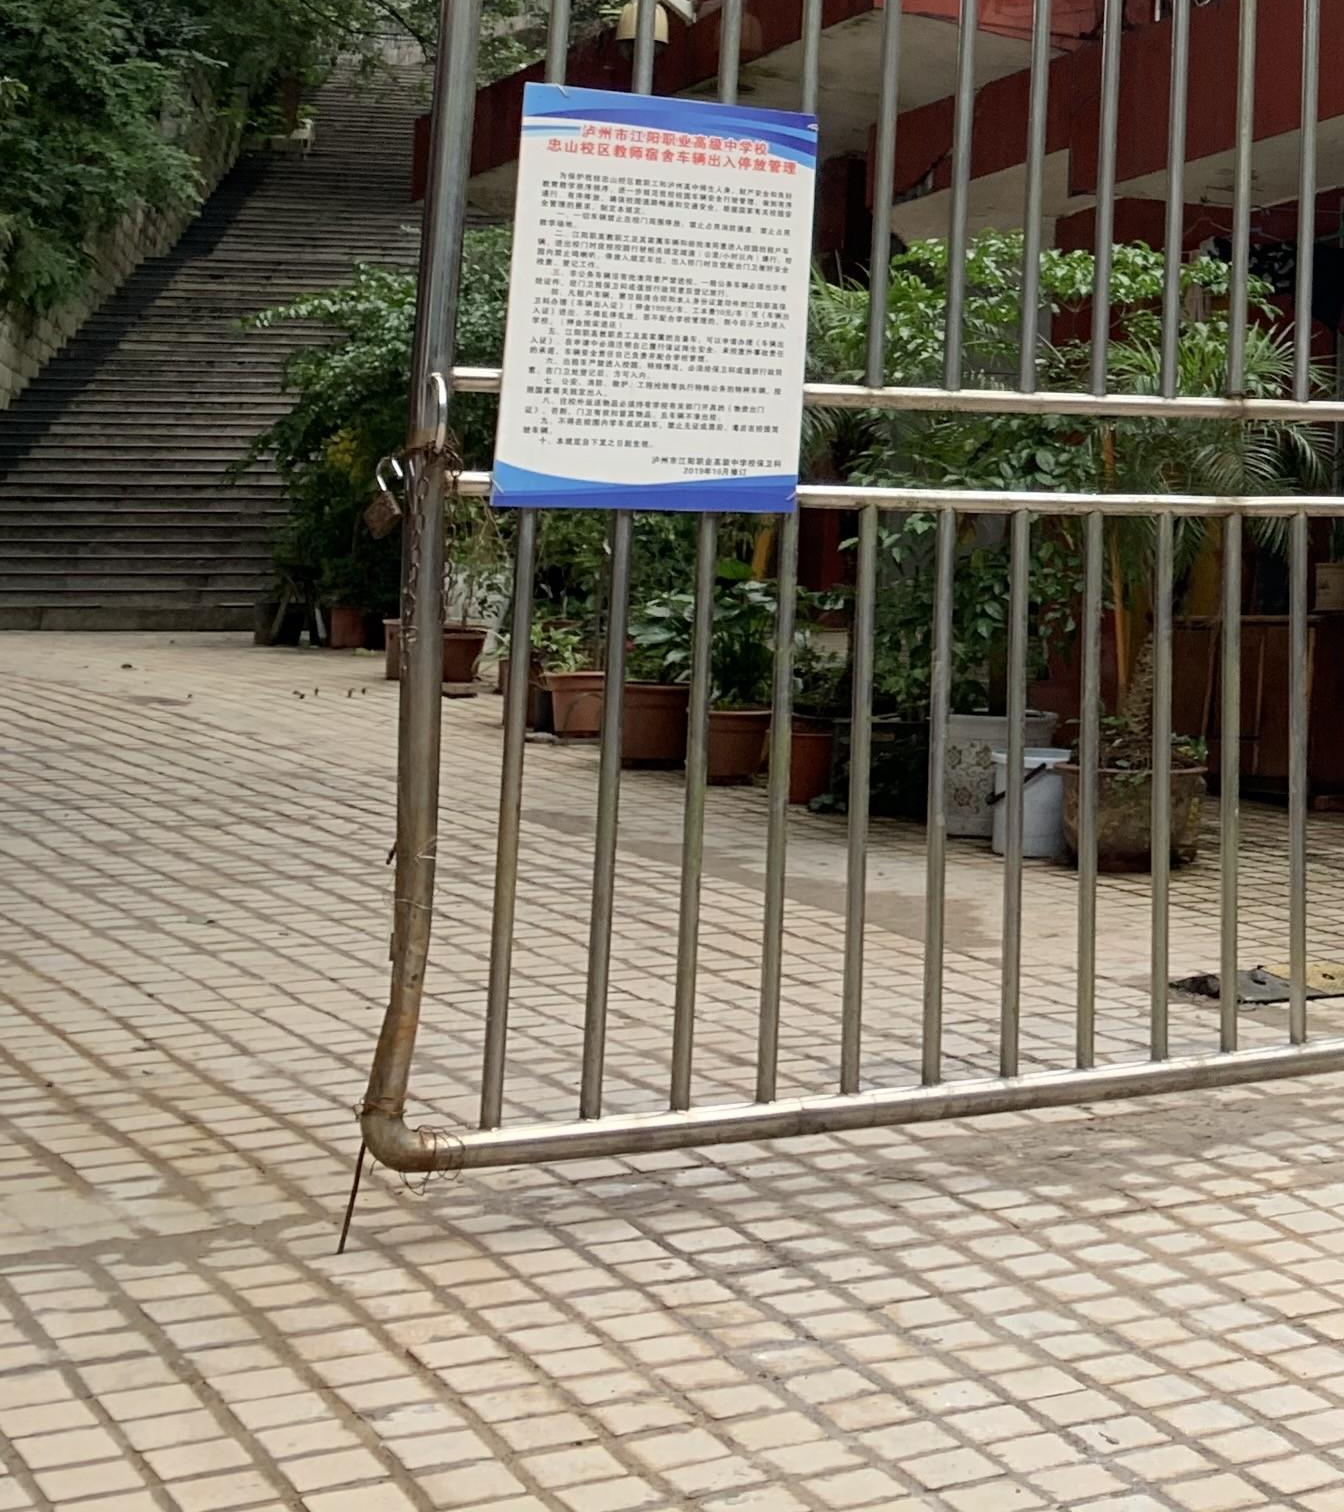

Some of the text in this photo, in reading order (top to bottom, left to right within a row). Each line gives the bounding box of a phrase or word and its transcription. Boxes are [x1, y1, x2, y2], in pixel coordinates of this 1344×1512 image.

[547, 136, 797, 176] 忠山校区教师宿舍车辆出入停放管理
[581, 124, 769, 156] 泸州市江阳职业高级中学校
